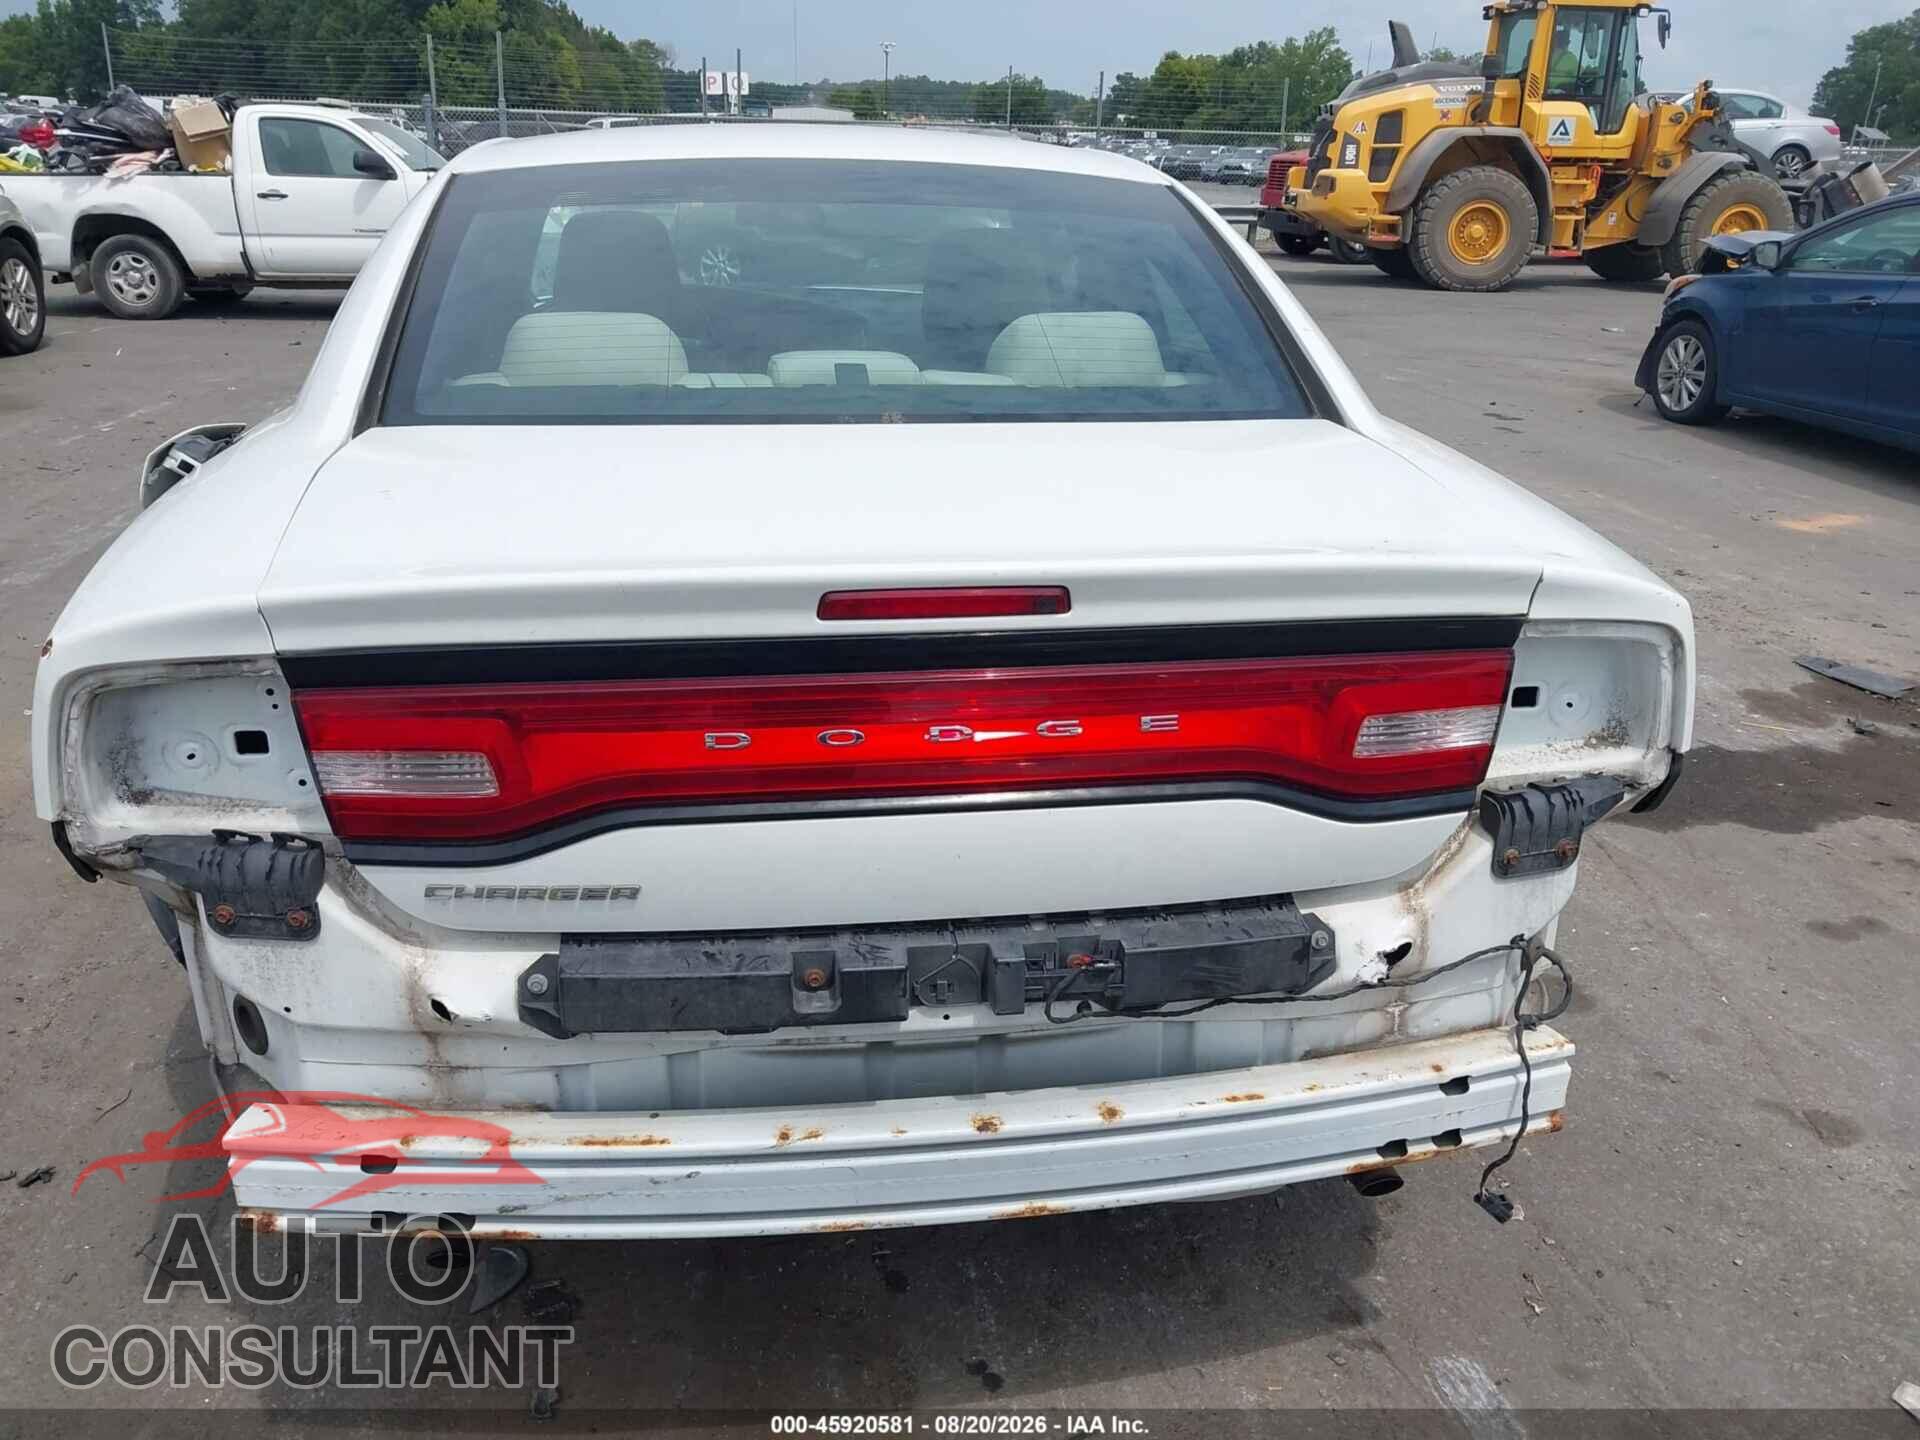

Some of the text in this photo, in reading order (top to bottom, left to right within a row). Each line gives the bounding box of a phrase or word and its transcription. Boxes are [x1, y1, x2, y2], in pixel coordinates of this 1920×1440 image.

[707, 76, 717, 90] P
[1438, 84, 1482, 92] VOLVO
[703, 714, 1180, 750] DODGE
[424, 884, 642, 901] CHARGER
